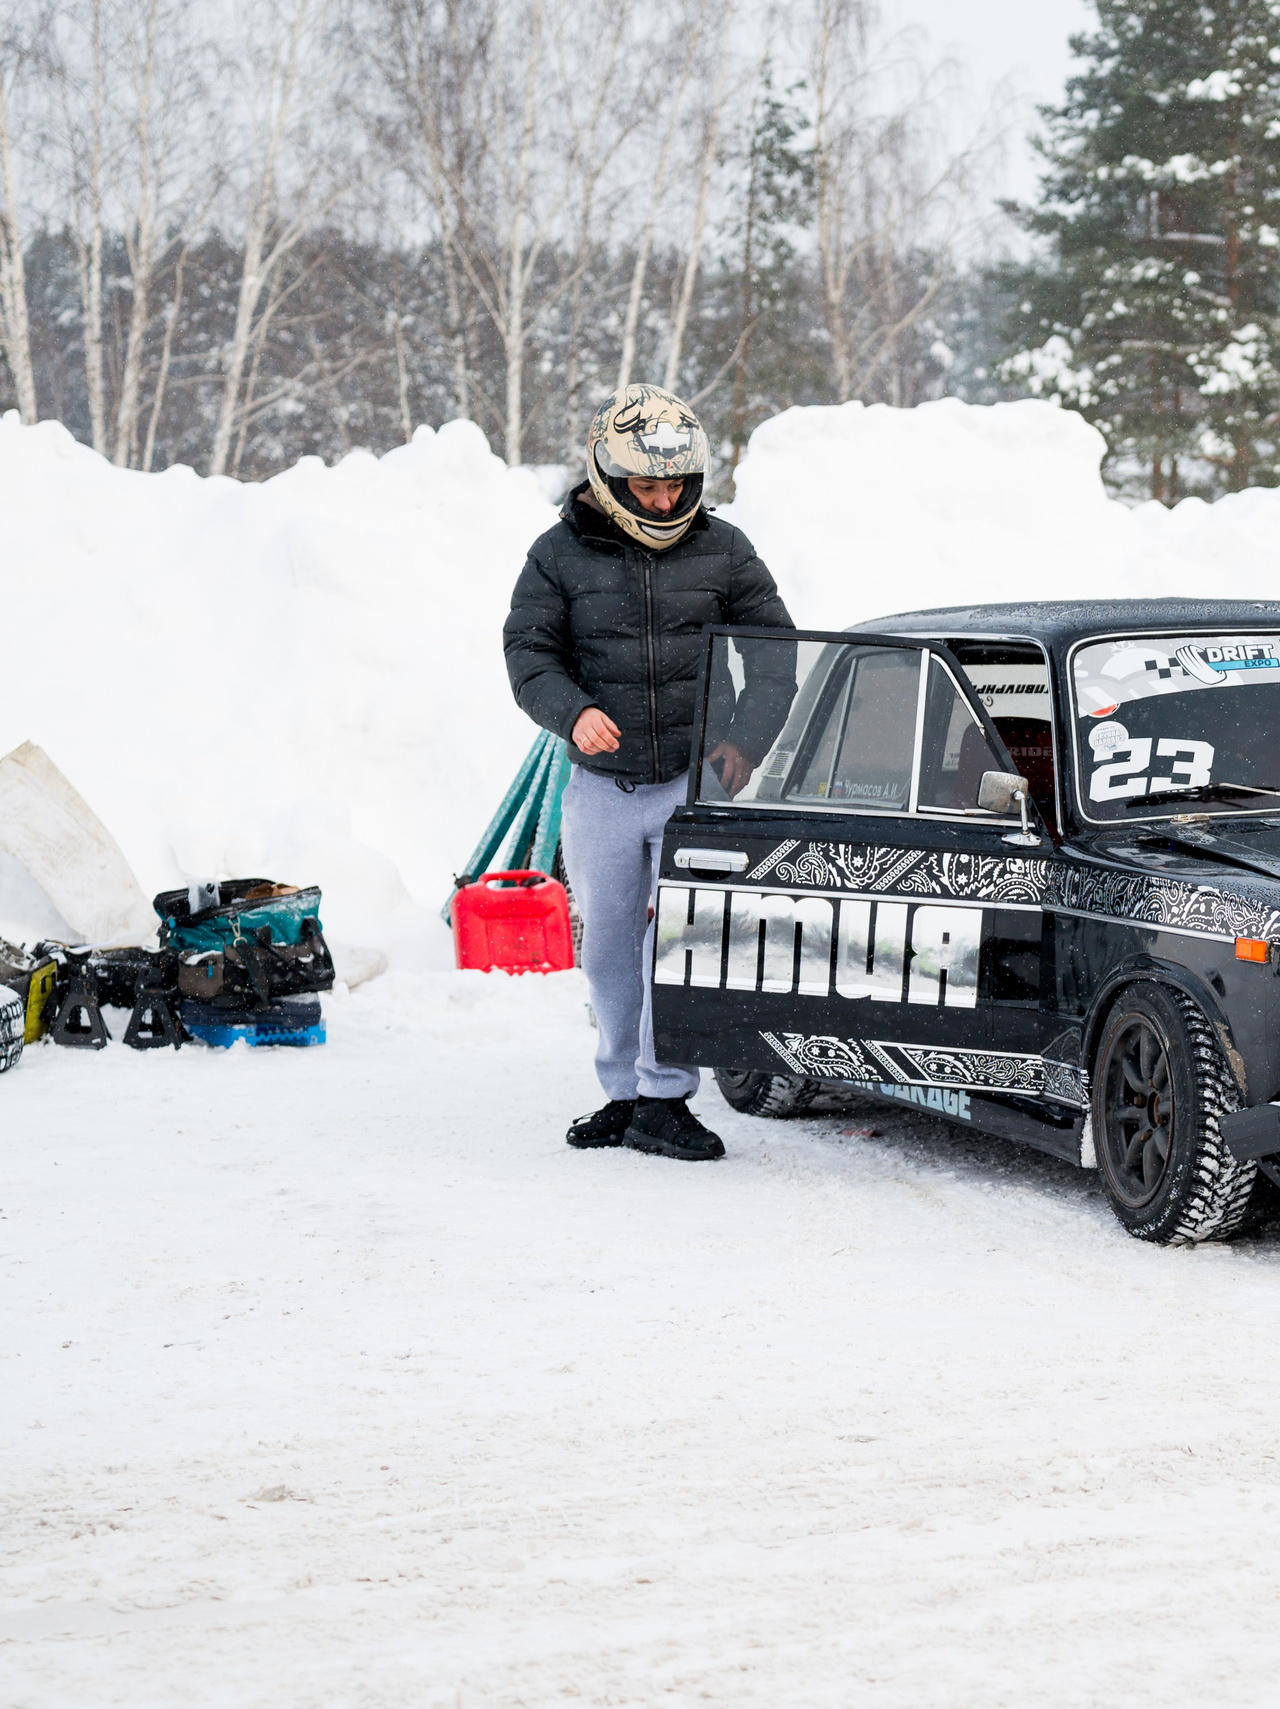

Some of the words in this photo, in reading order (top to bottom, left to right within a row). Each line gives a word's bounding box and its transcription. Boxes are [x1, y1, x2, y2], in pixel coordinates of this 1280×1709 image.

[1205, 644, 1274, 663] DRIFT
[1244, 659, 1272, 668] EXPO
[1089, 737, 1215, 802] 23
